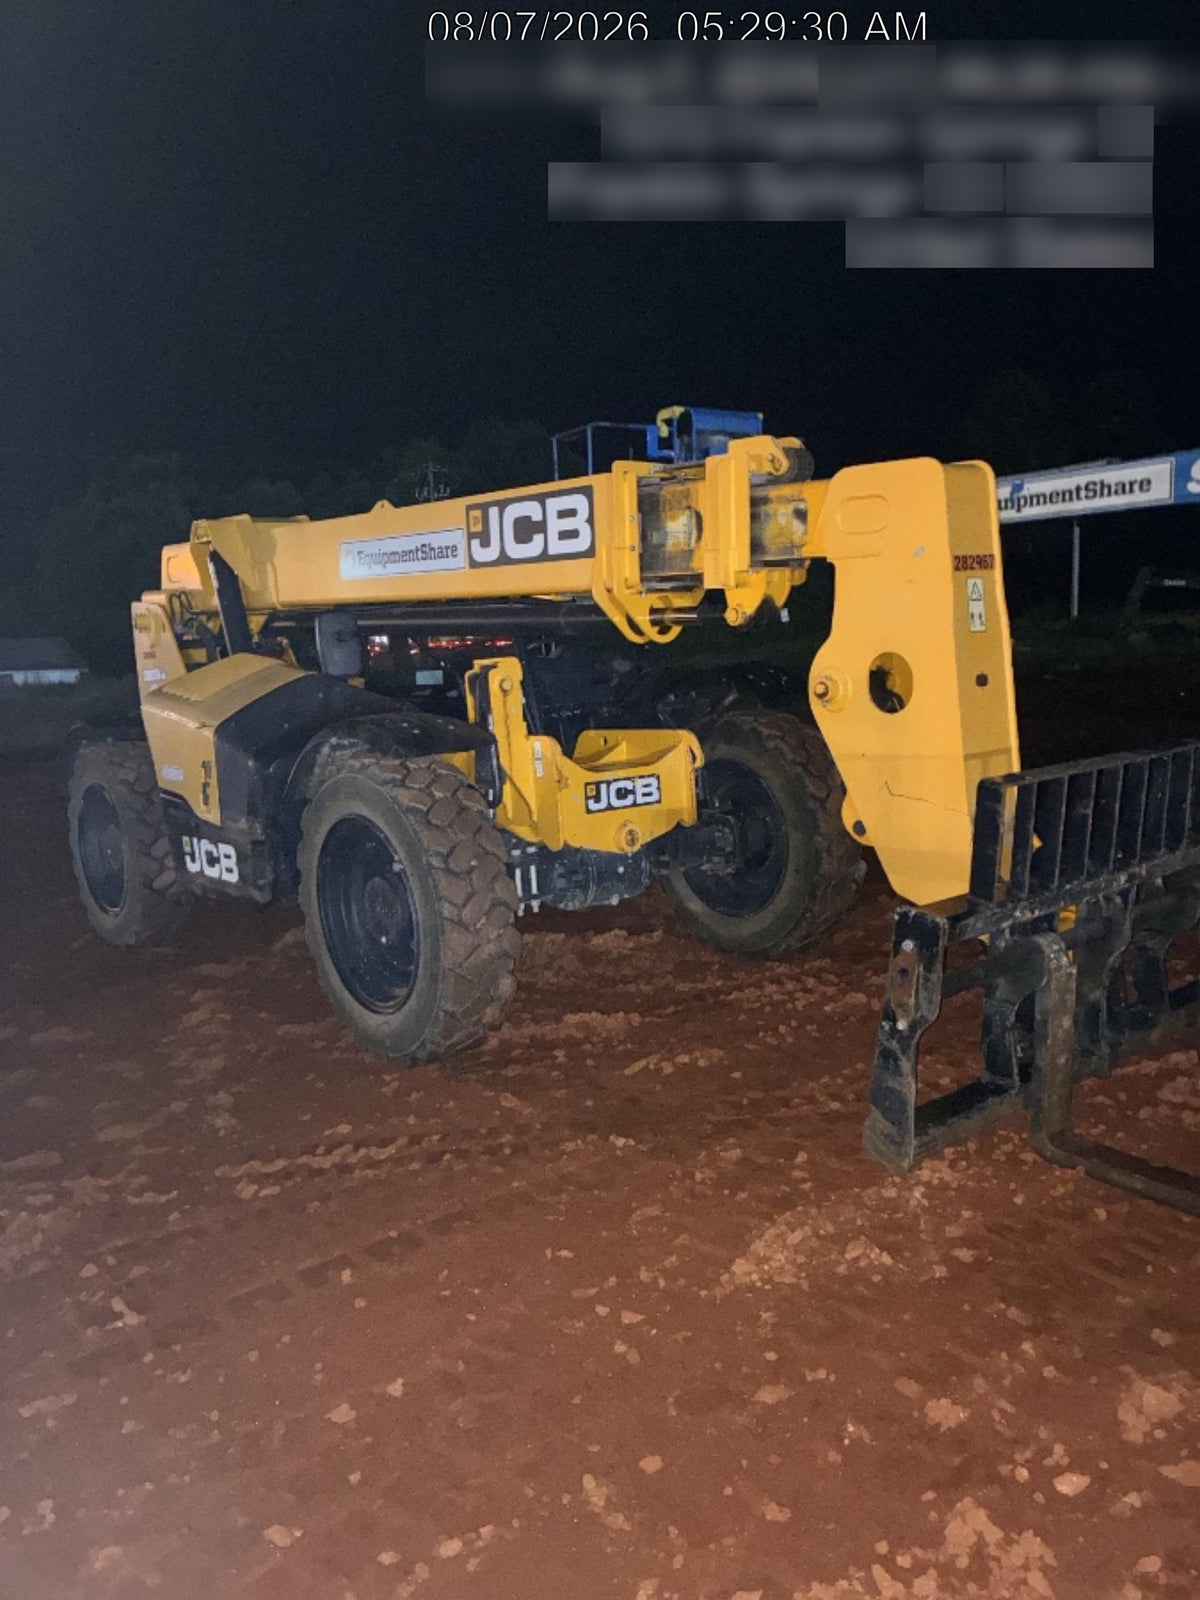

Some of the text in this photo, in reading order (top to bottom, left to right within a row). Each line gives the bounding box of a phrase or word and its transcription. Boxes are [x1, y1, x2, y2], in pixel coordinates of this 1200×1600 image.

[471, 493, 593, 563] JCB
[356, 542, 459, 569] EquipmentShare
[587, 776, 661, 812] JCB
[185, 836, 239, 883] JCB
